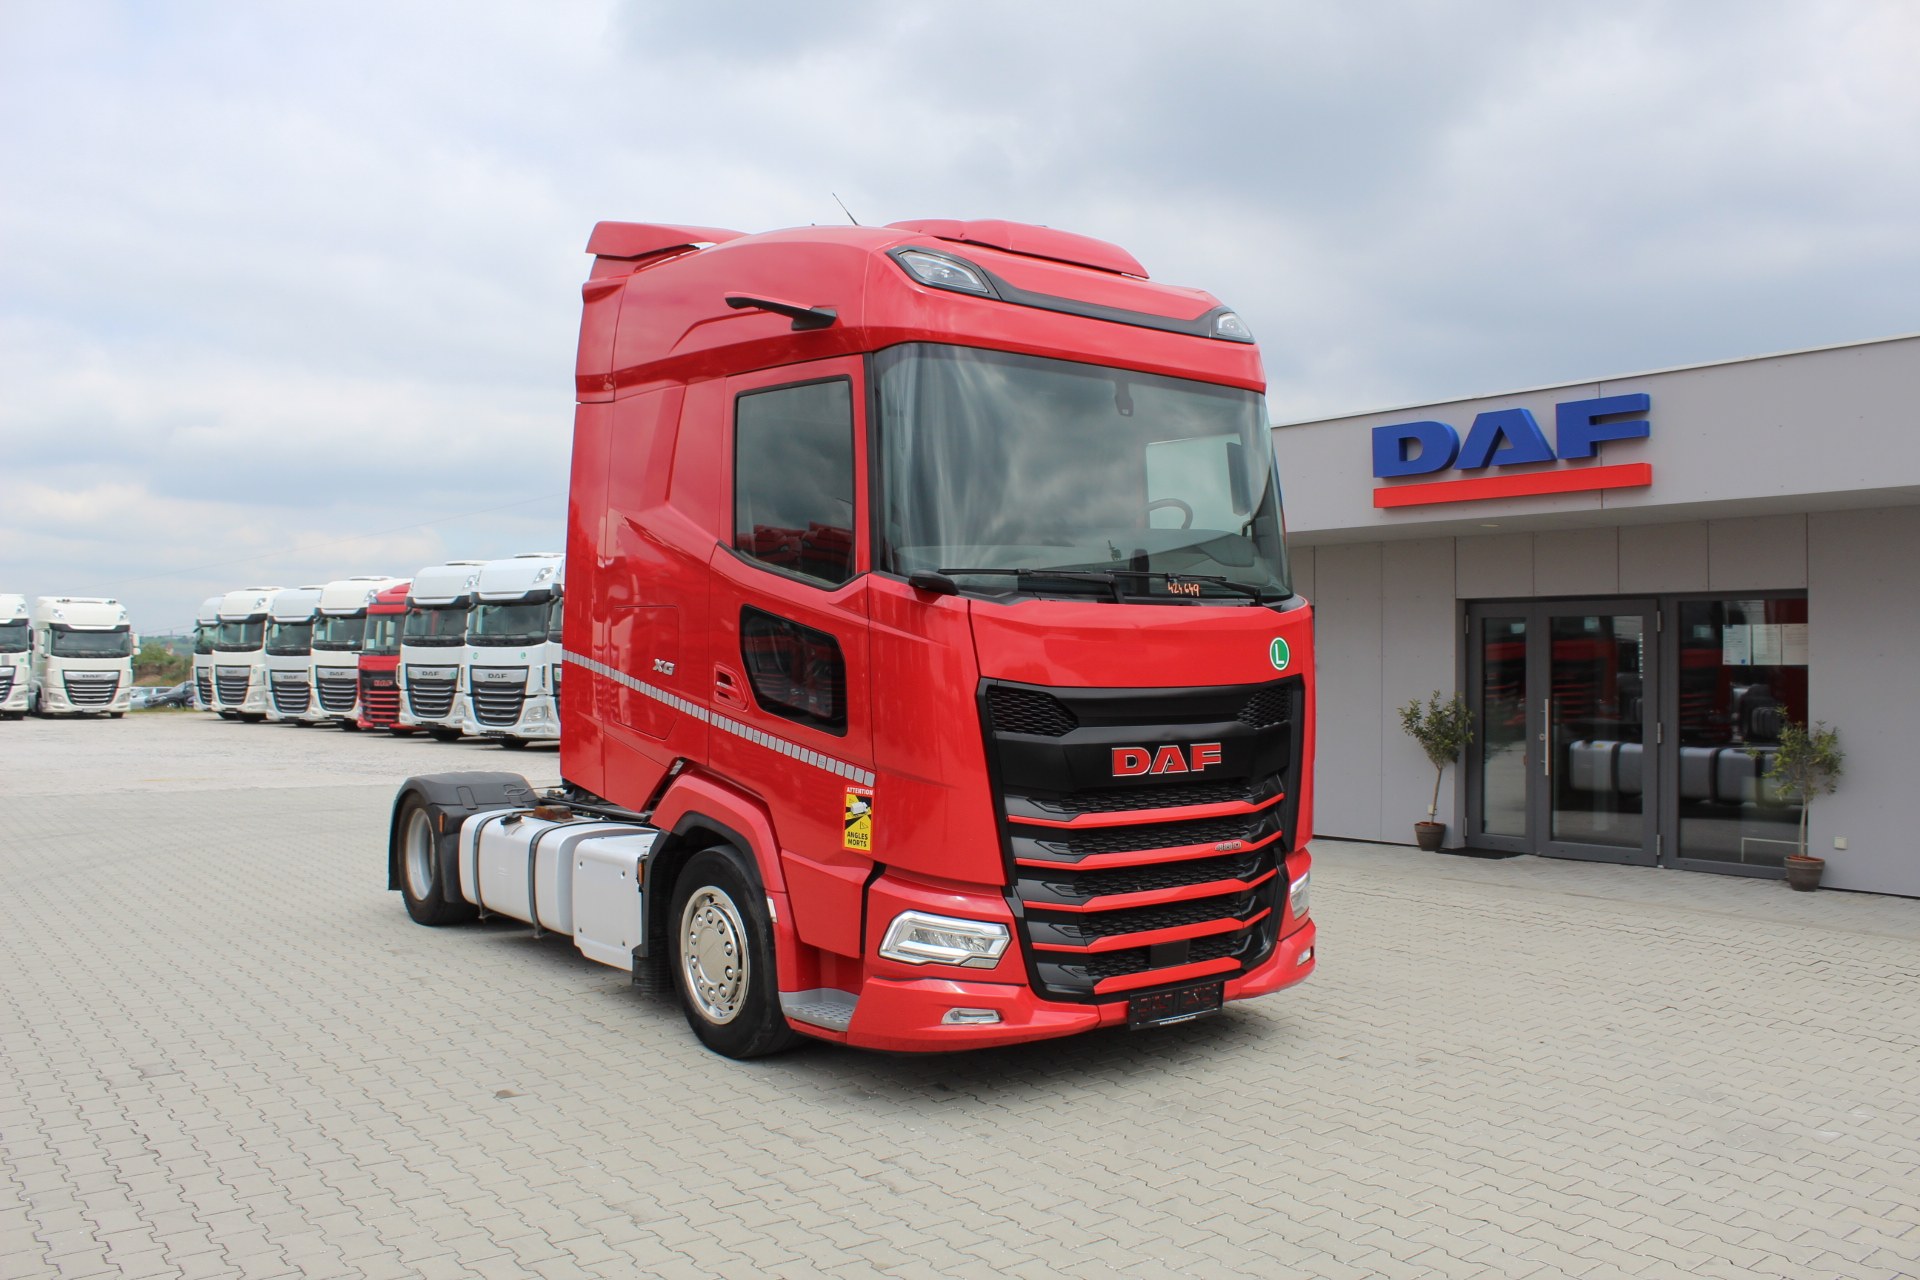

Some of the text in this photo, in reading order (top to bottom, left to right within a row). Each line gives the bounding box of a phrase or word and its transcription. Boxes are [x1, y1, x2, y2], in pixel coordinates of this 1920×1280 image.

[1372, 393, 1650, 478] DAF
[652, 658, 675, 676] XG
[1111, 743, 1222, 777] DAF
[846, 787, 873, 795] ATTENTION
[847, 831, 868, 840] ANGLES
[848, 839, 867, 847] MORTS
